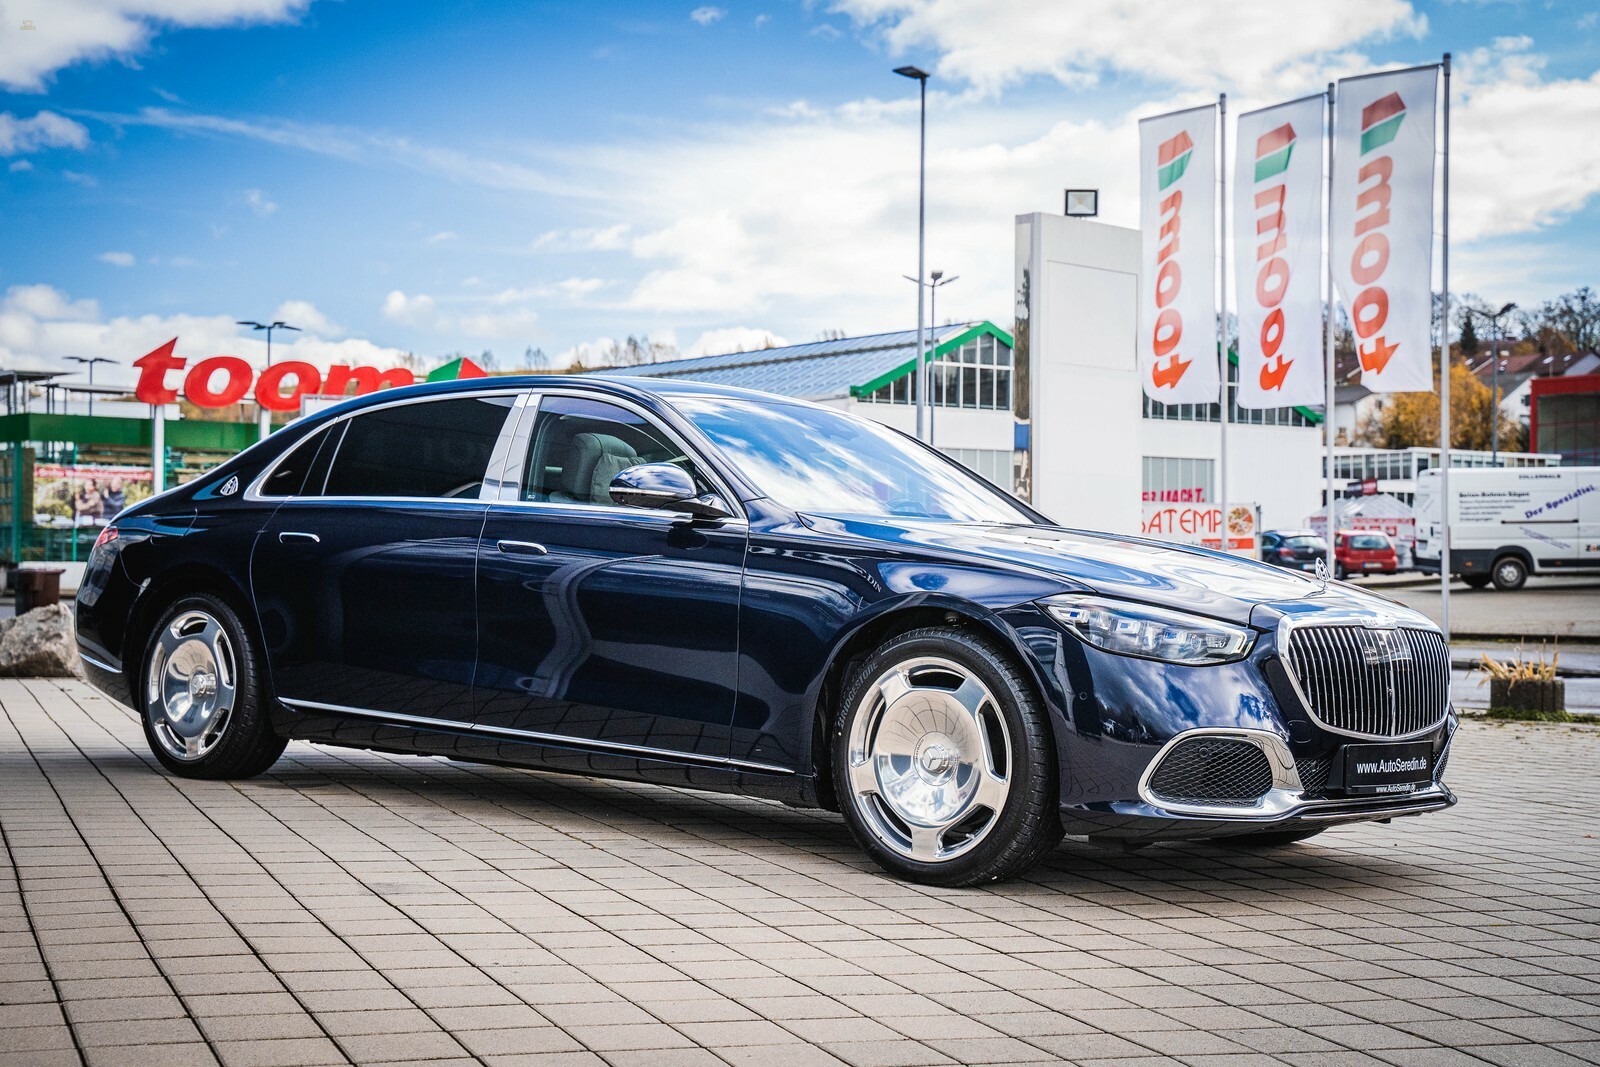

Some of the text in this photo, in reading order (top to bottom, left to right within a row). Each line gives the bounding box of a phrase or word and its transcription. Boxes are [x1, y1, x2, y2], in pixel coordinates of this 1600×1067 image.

[1152, 190, 1192, 390] toom
[1255, 184, 1293, 392] toom
[1351, 156, 1400, 376] toom
[133, 337, 415, 412] toom
[1525, 506, 1543, 518] Der
[837, 658, 879, 730] BRIDGESTONE
[1356, 756, 1427, 774] www.AutoSeredin.de
